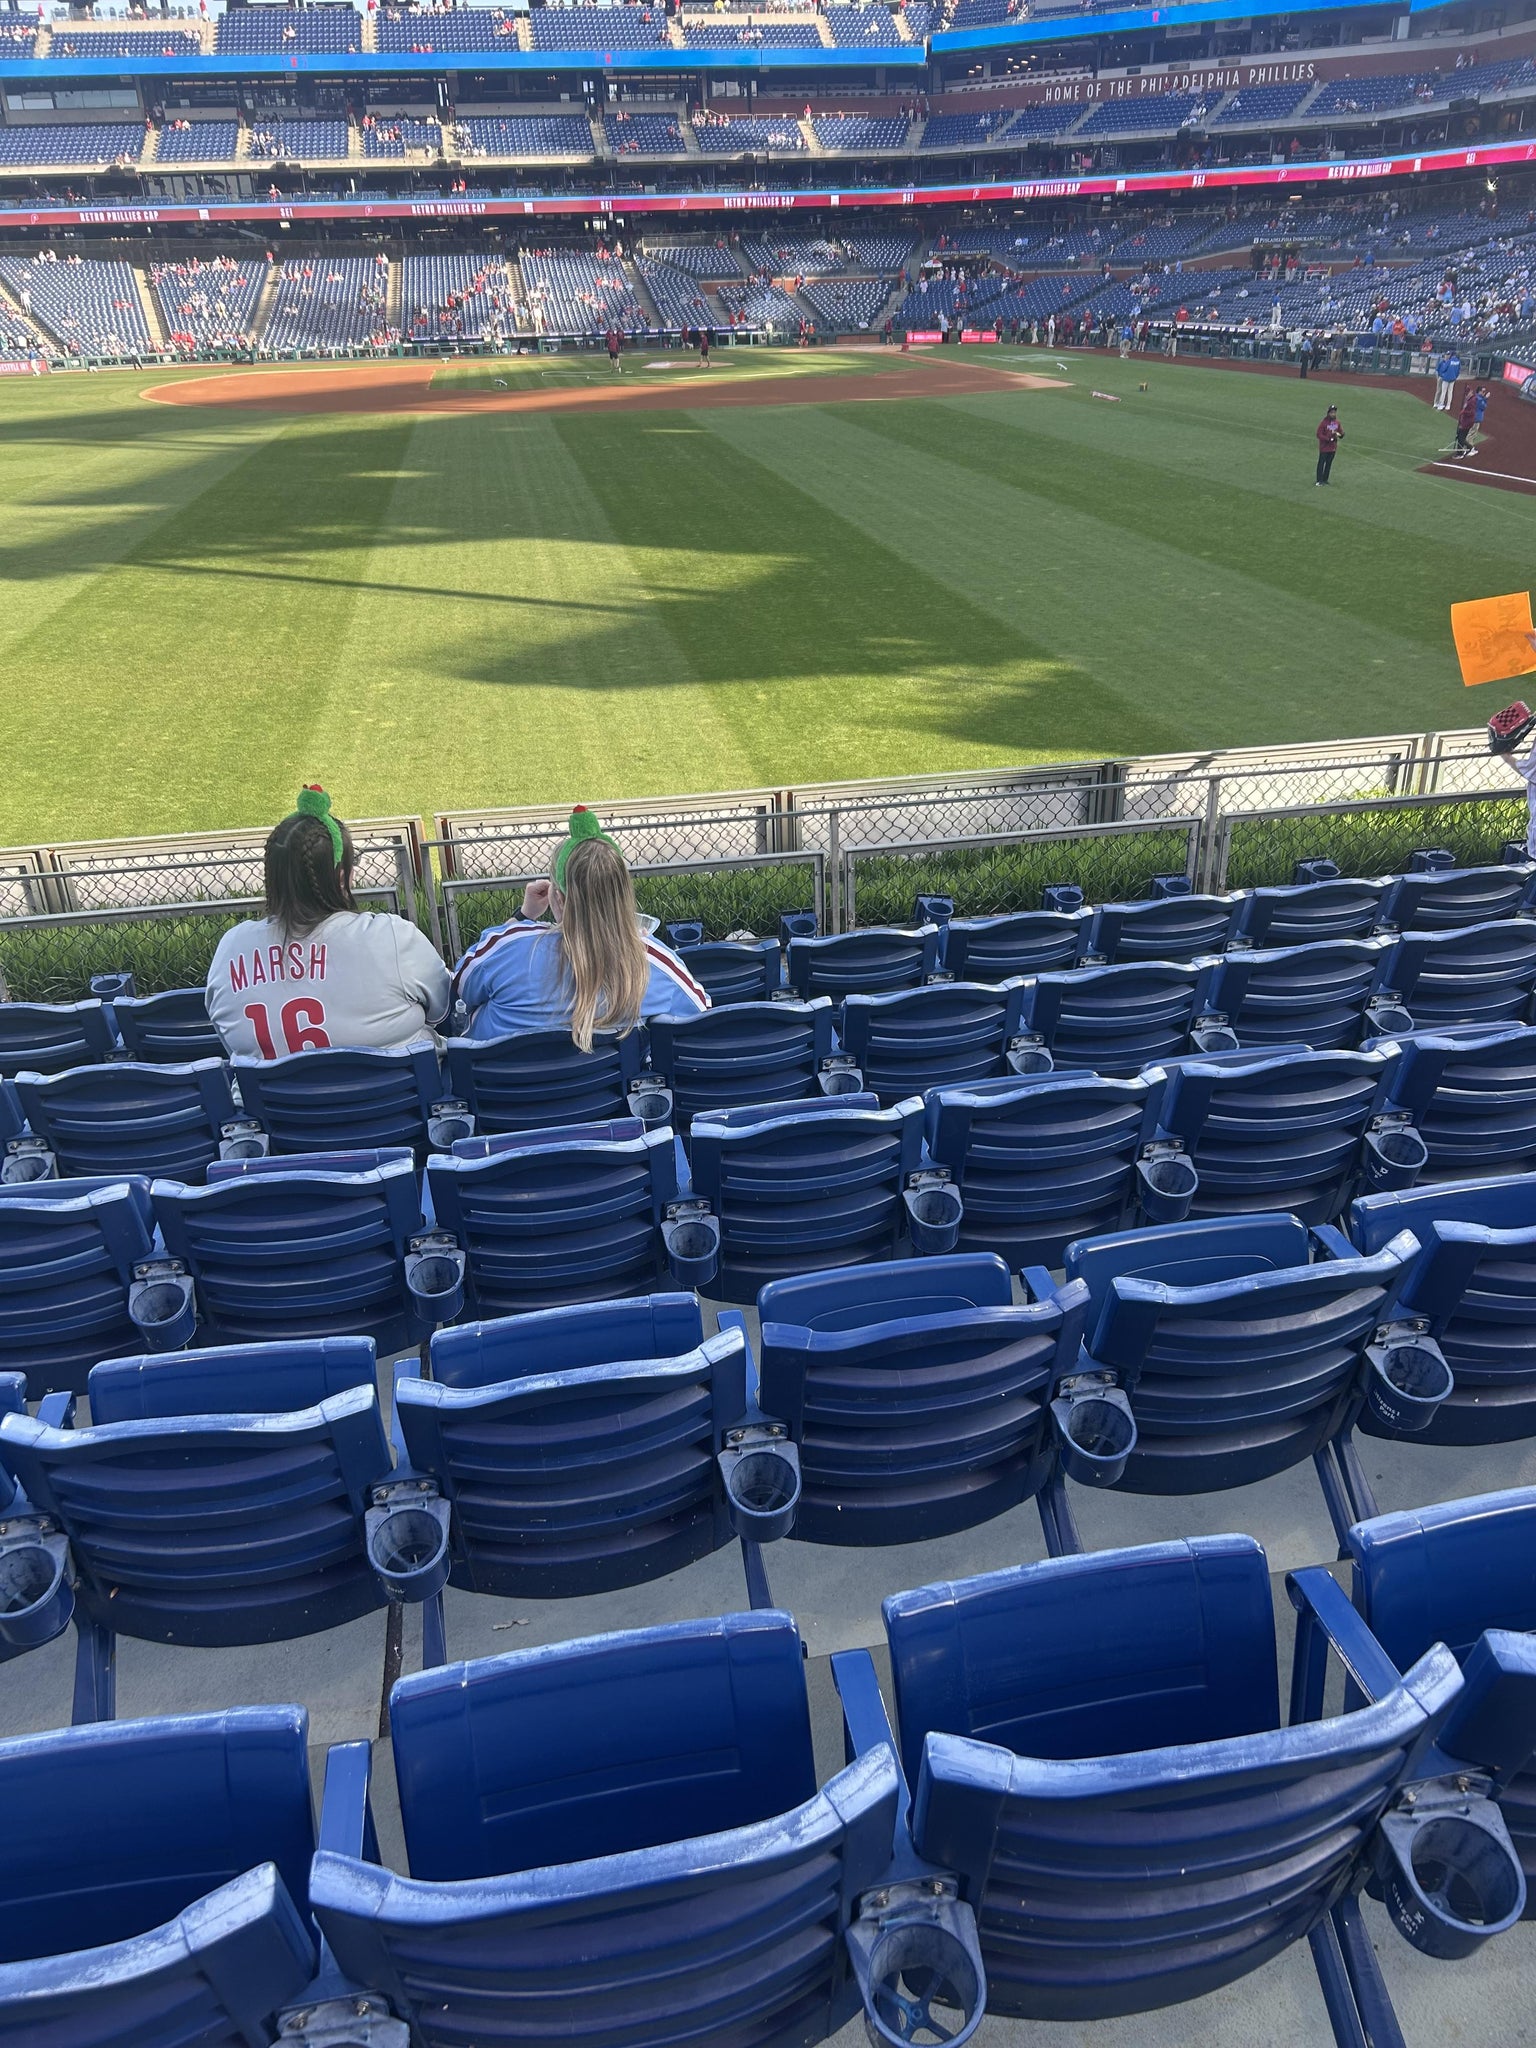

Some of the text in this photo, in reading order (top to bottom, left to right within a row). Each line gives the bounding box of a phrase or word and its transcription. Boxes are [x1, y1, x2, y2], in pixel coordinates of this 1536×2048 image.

[1046, 85, 1080, 101] HOME
[1087, 83, 1101, 98] OF
[1110, 80, 1133, 96] THE
[1249, 63, 1314, 84] PHILLIES
[411, 203, 486, 214] RETRO PHILLIES CAP
[723, 196, 795, 207] RETRO PHILLIES CAP
[80, 210, 159, 222] RETRO PHILLIES CAP
[229, 942, 327, 994] MARSH
[243, 996, 333, 1060] 16
